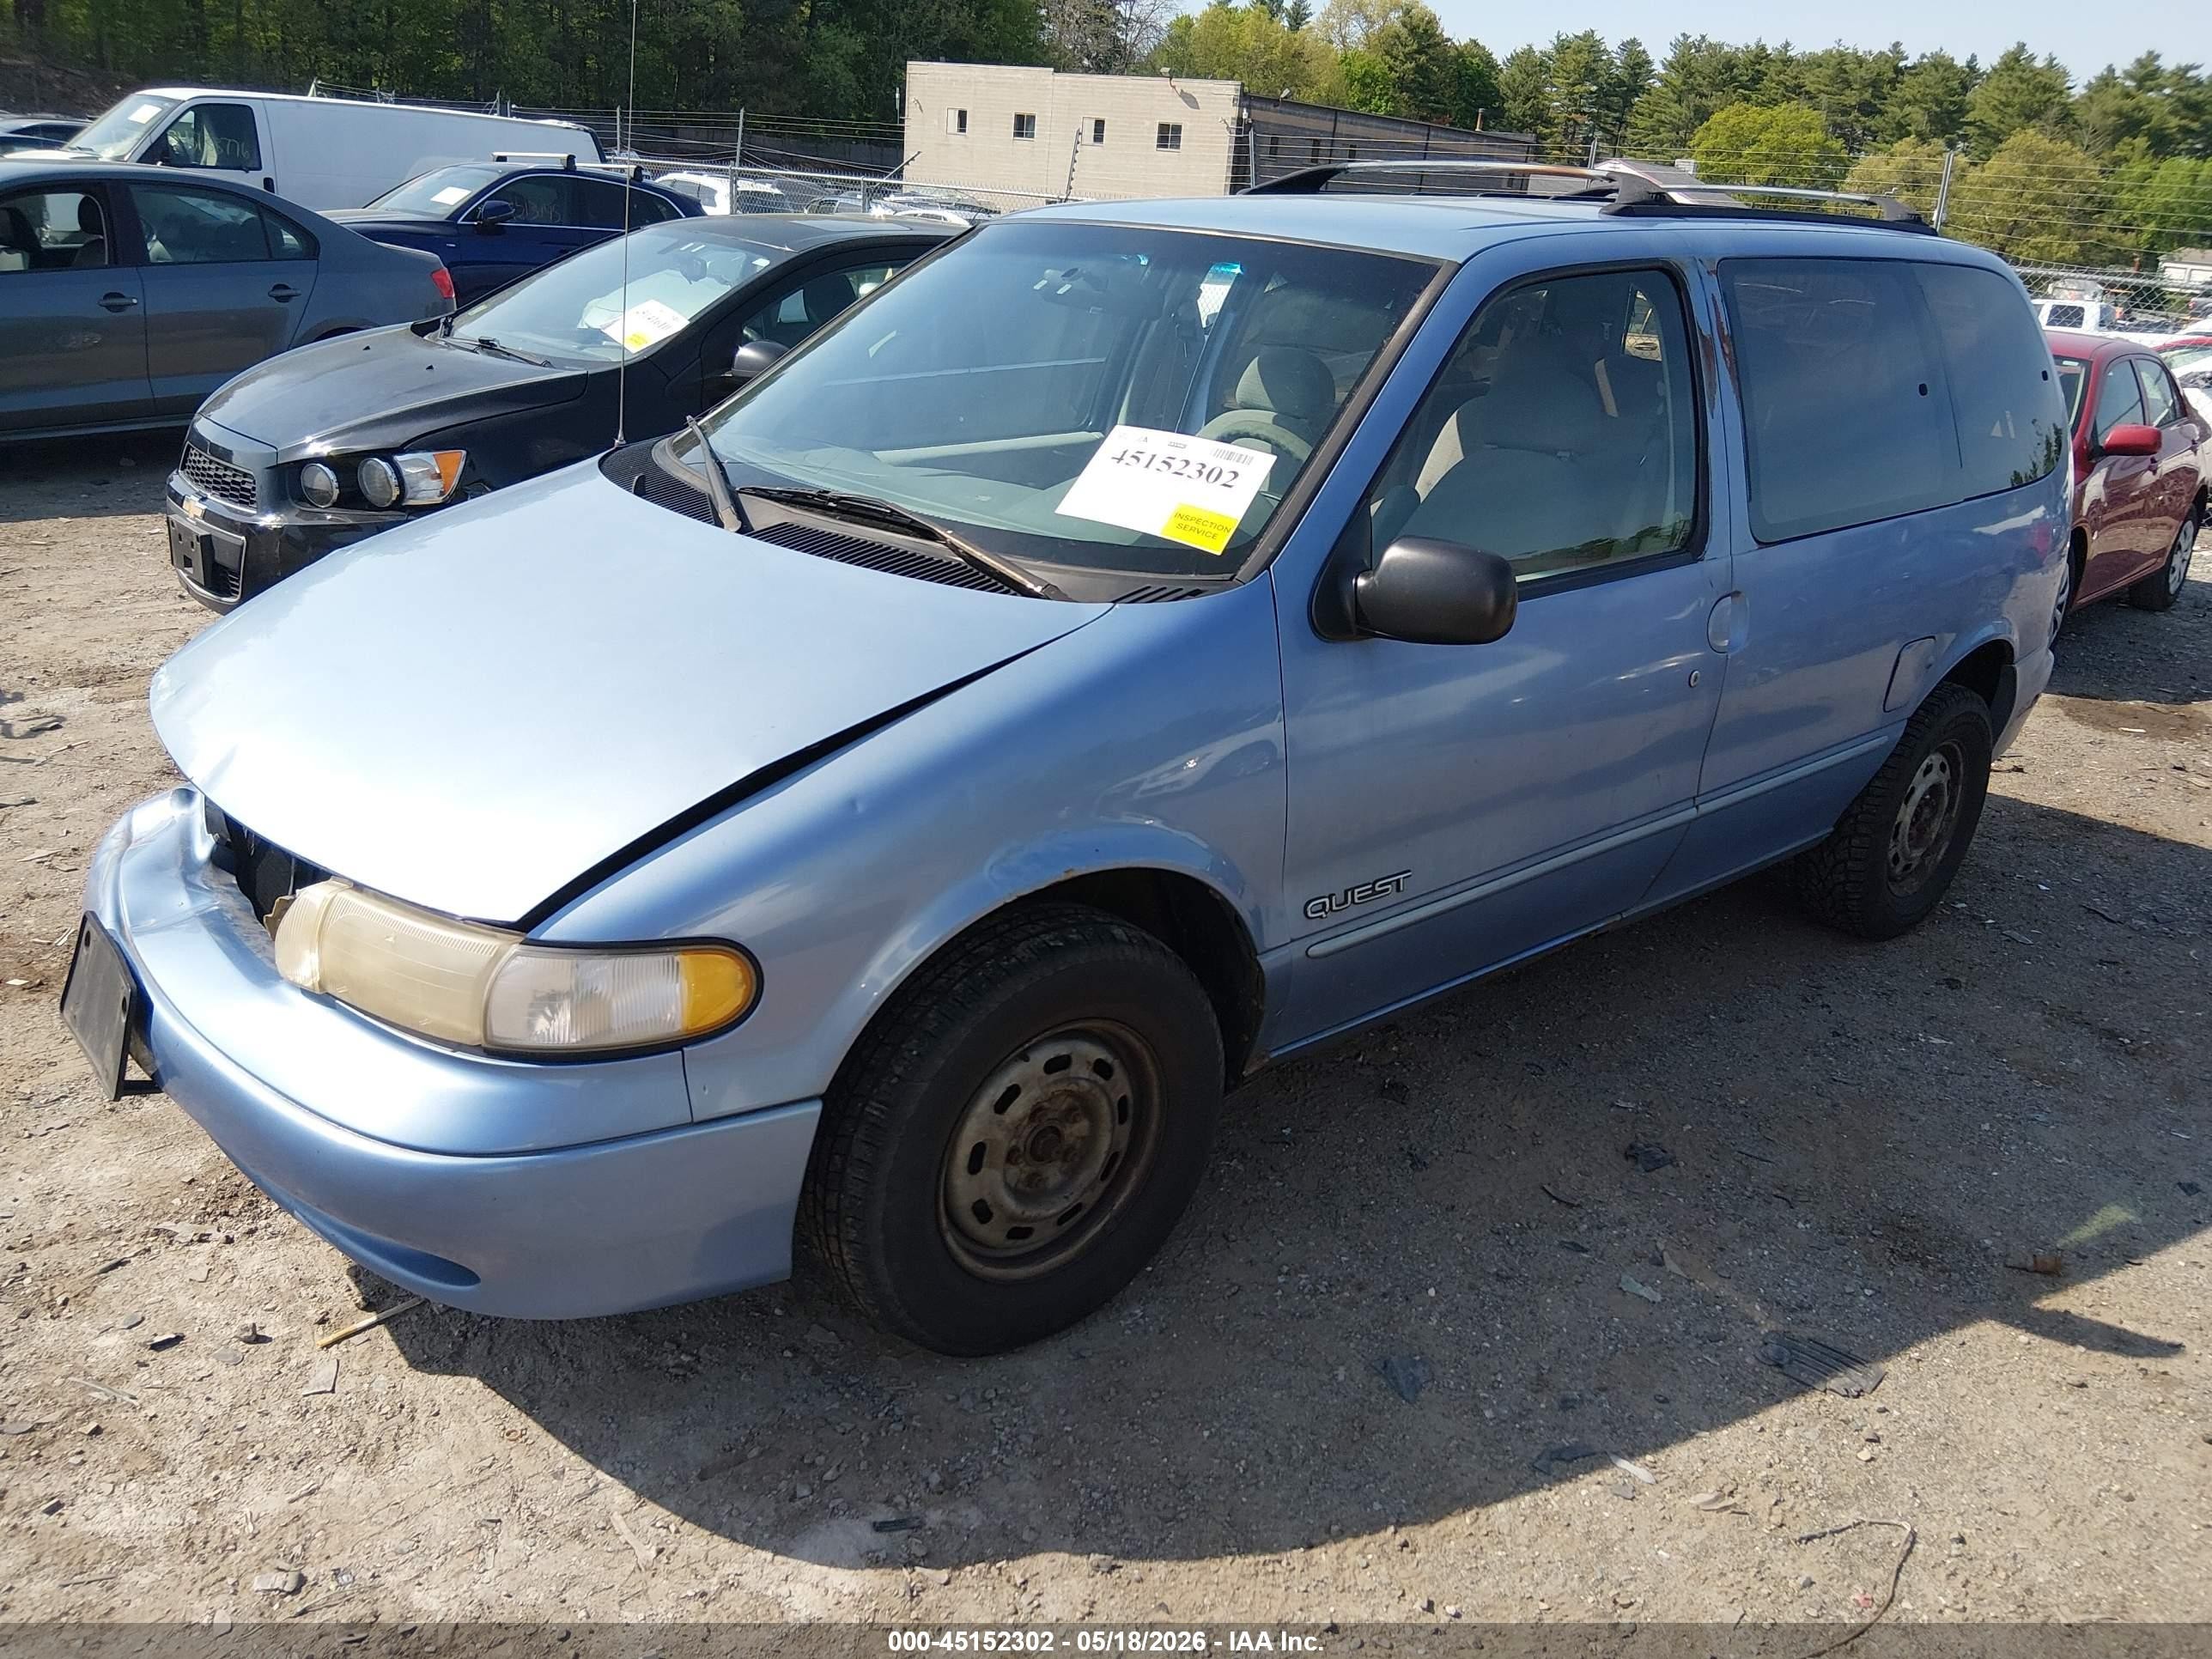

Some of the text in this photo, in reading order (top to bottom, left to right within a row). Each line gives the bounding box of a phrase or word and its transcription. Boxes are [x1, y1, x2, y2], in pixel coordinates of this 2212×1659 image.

[1111, 449, 1239, 489] 45152302
[1174, 512, 1231, 533] INSPECTION
[1176, 522, 1218, 539] SERVICE
[1304, 870, 1412, 919] QUEST
